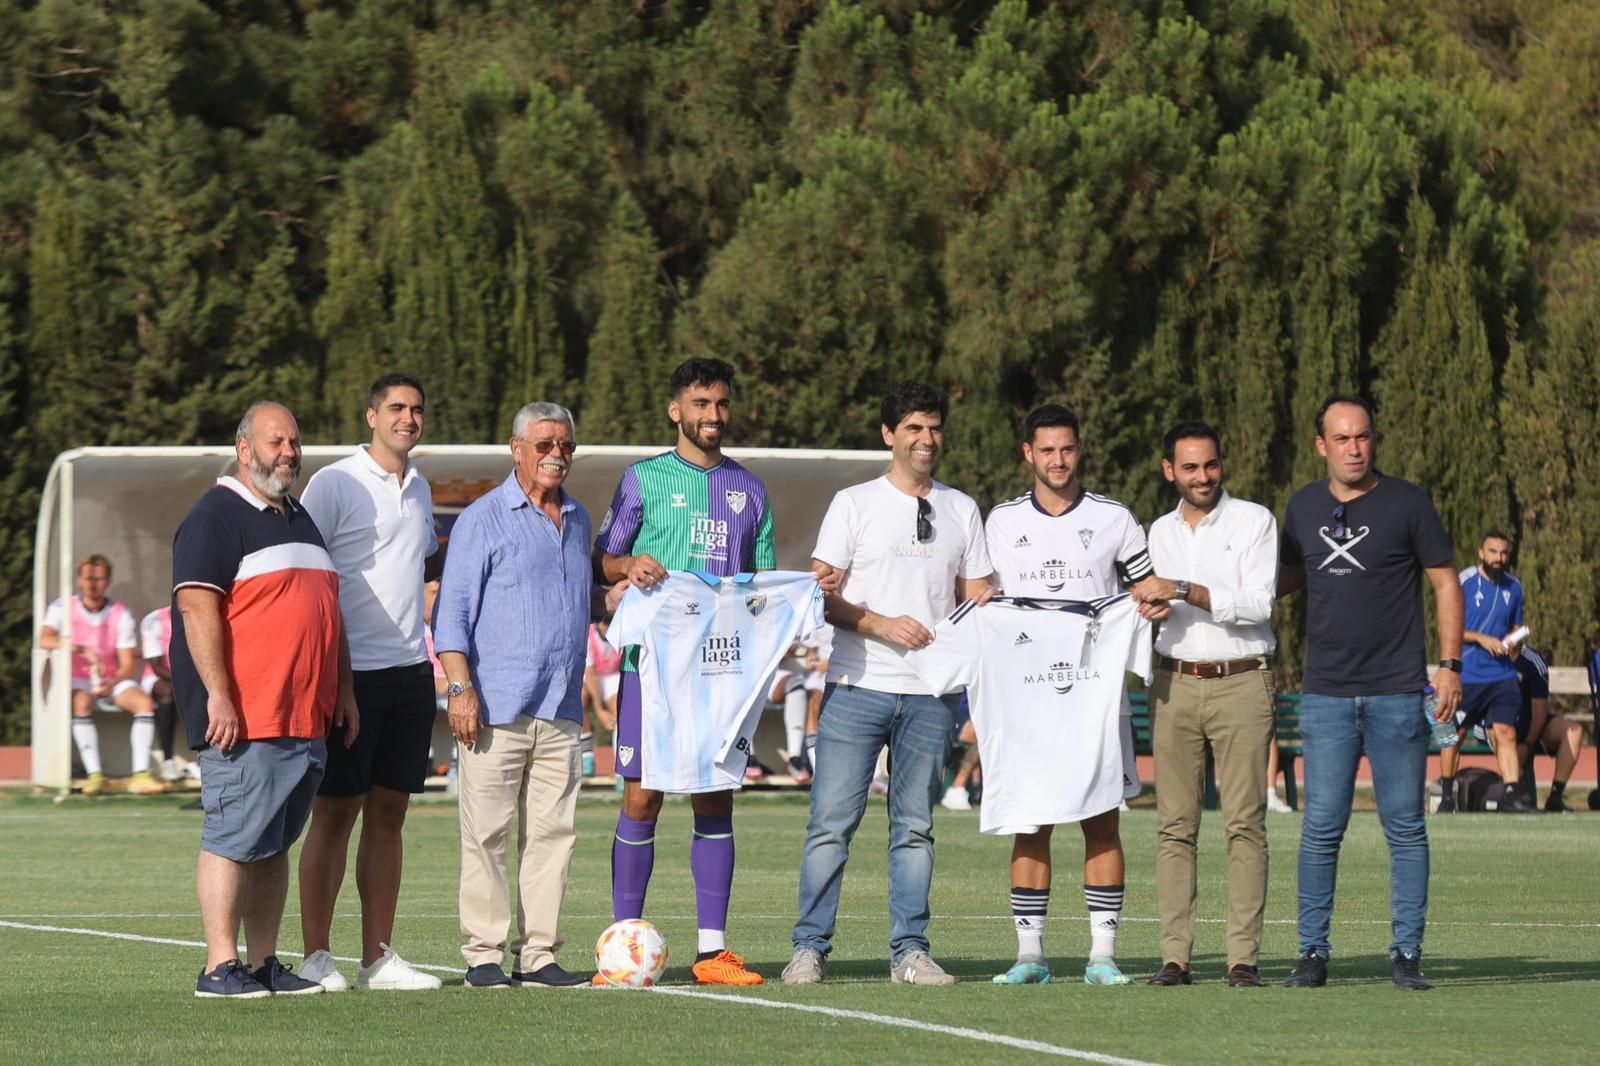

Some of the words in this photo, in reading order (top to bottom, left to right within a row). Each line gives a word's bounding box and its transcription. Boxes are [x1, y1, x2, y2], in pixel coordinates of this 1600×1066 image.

[690, 526, 727, 551] laga
[1019, 568, 1094, 582] MARBELLA
[709, 630, 741, 650] má
[702, 646, 742, 667] laga
[1024, 669, 1101, 685] MARBELLA
